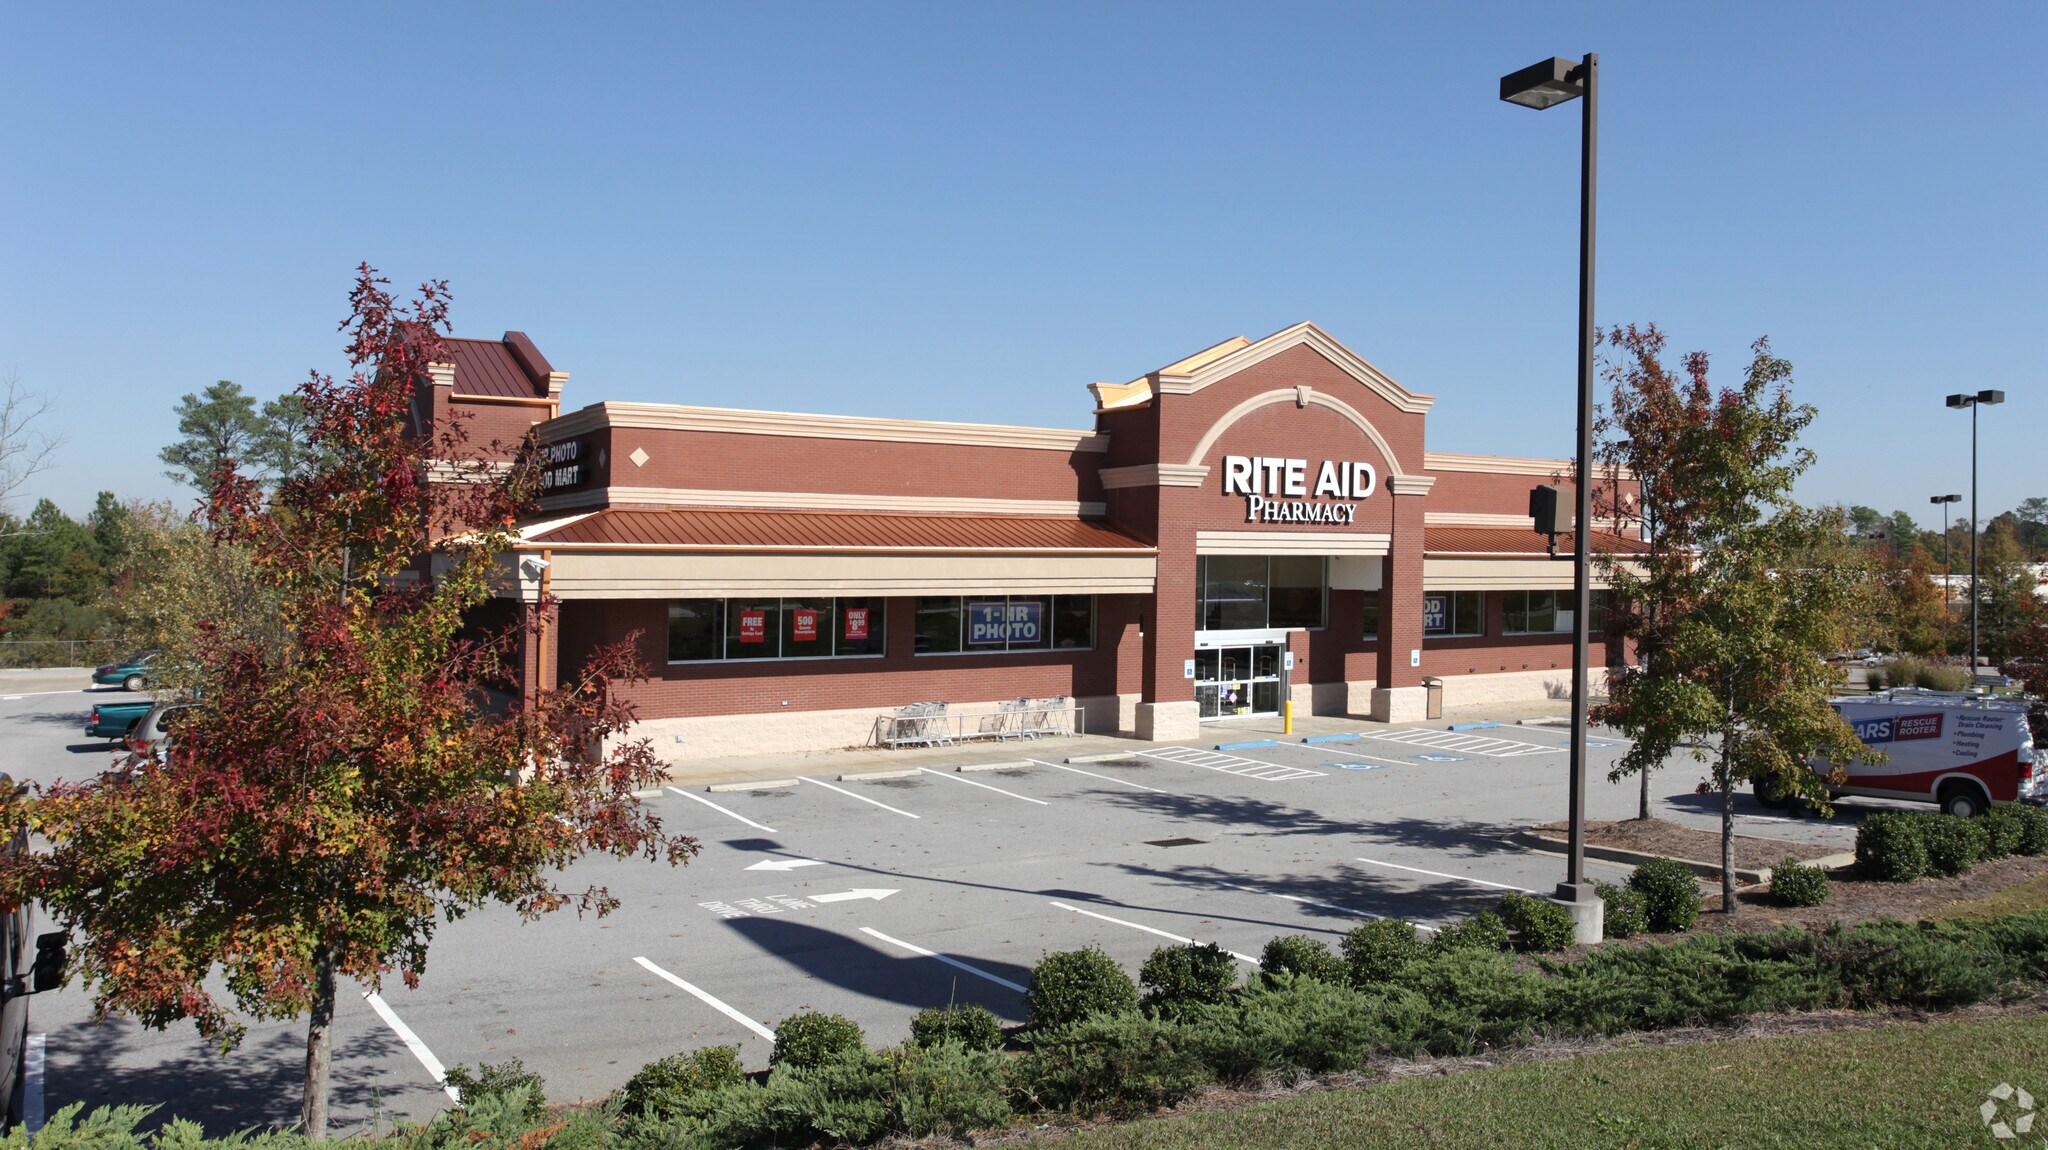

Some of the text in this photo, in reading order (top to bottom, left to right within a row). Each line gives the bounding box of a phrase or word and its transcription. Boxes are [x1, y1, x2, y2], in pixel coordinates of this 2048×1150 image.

[551, 441, 577, 463] PHOTO
[542, 465, 578, 489] OD MART
[1225, 455, 1377, 497] RITE AID
[1248, 494, 1357, 523] PHARMACY
[1425, 600, 1441, 613] OD
[797, 615, 813, 625] 500
[848, 611, 866, 620] ONLY
[983, 606, 1029, 622] 1-HR
[1425, 613, 1443, 627] RT
[742, 616, 763, 626] FREE
[973, 622, 1036, 639] PHOTO
[1901, 717, 1938, 727] RESCUE
[1975, 722, 2003, 731] Cleaning
[1899, 725, 1936, 736] ROOTER
[1956, 730, 1985, 740] Plumbing
[1956, 740, 1980, 749] Heating
[1955, 749, 1978, 758] Cooling
[697, 901, 751, 918] DRIVE
